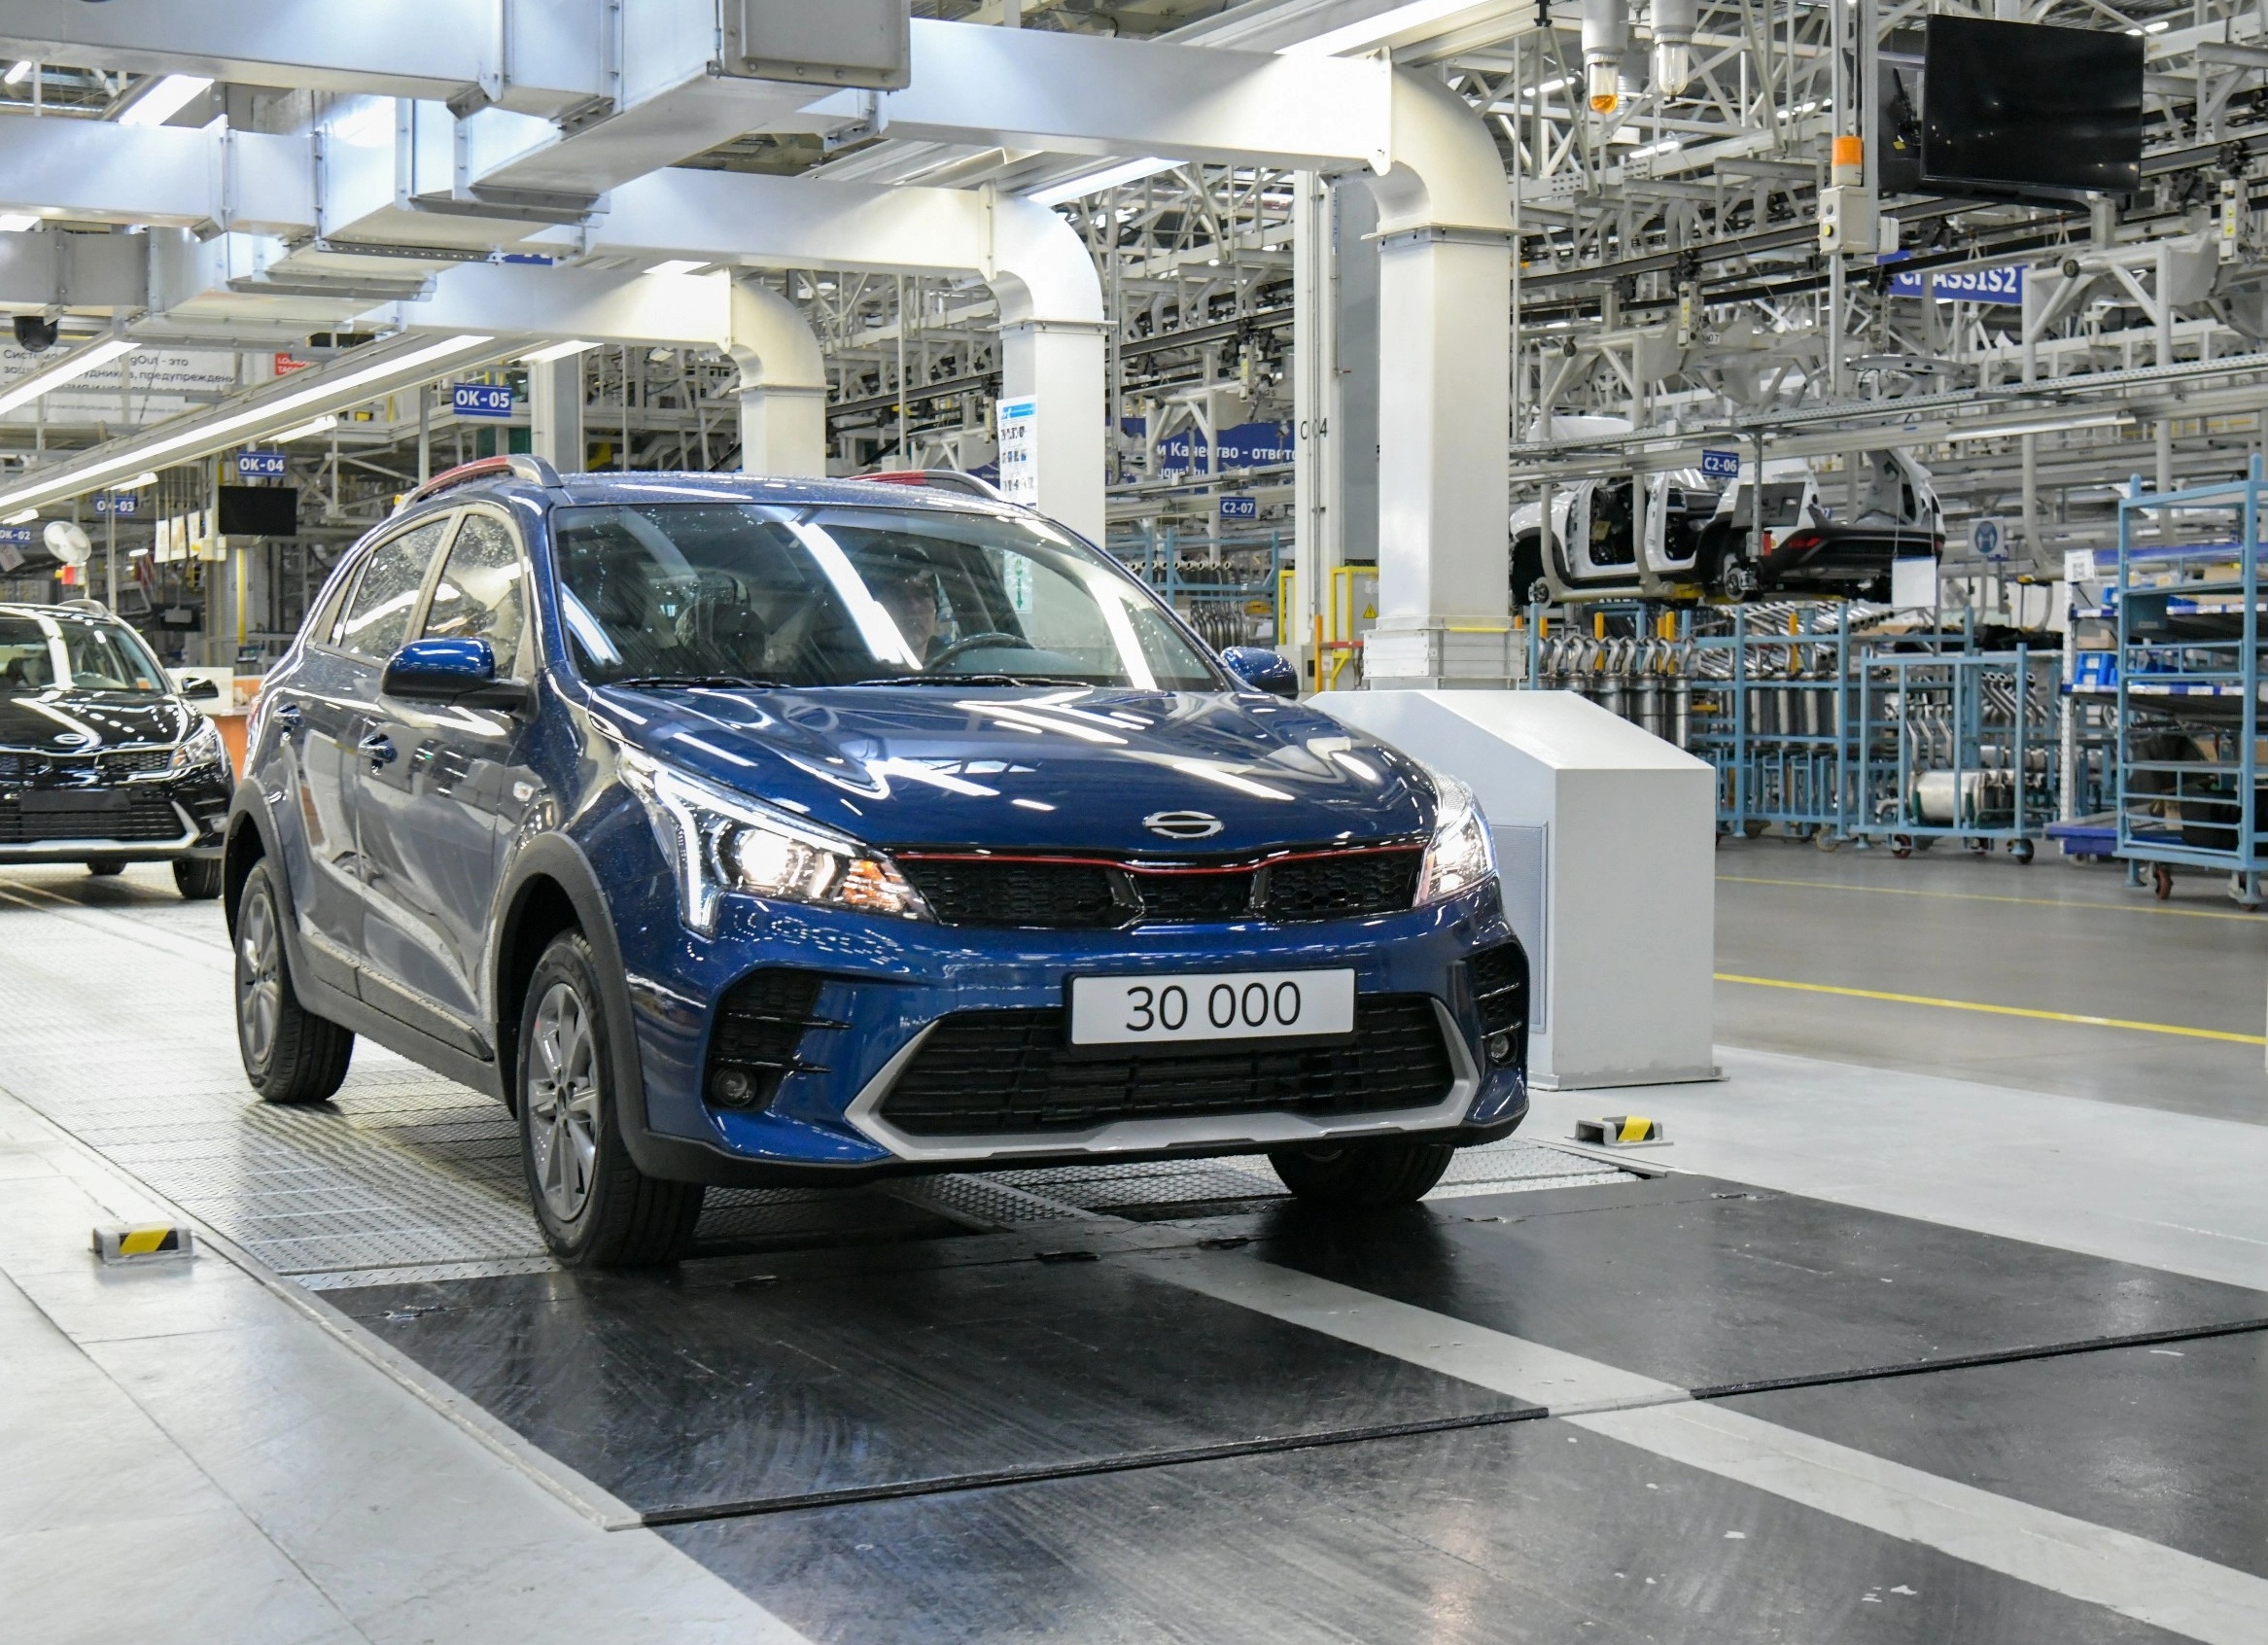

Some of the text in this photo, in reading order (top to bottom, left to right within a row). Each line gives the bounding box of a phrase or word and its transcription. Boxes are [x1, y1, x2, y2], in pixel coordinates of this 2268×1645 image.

[1899, 266, 2017, 294] CASSIS2
[455, 389, 509, 408] OK-05
[1170, 441, 1239, 459] Каетво
[239, 457, 285, 472] OK-04
[1704, 456, 1738, 472] C2-06
[96, 500, 135, 512] O-03
[1221, 502, 1254, 514] C2-07
[1126, 980, 1301, 1032] 30 000
